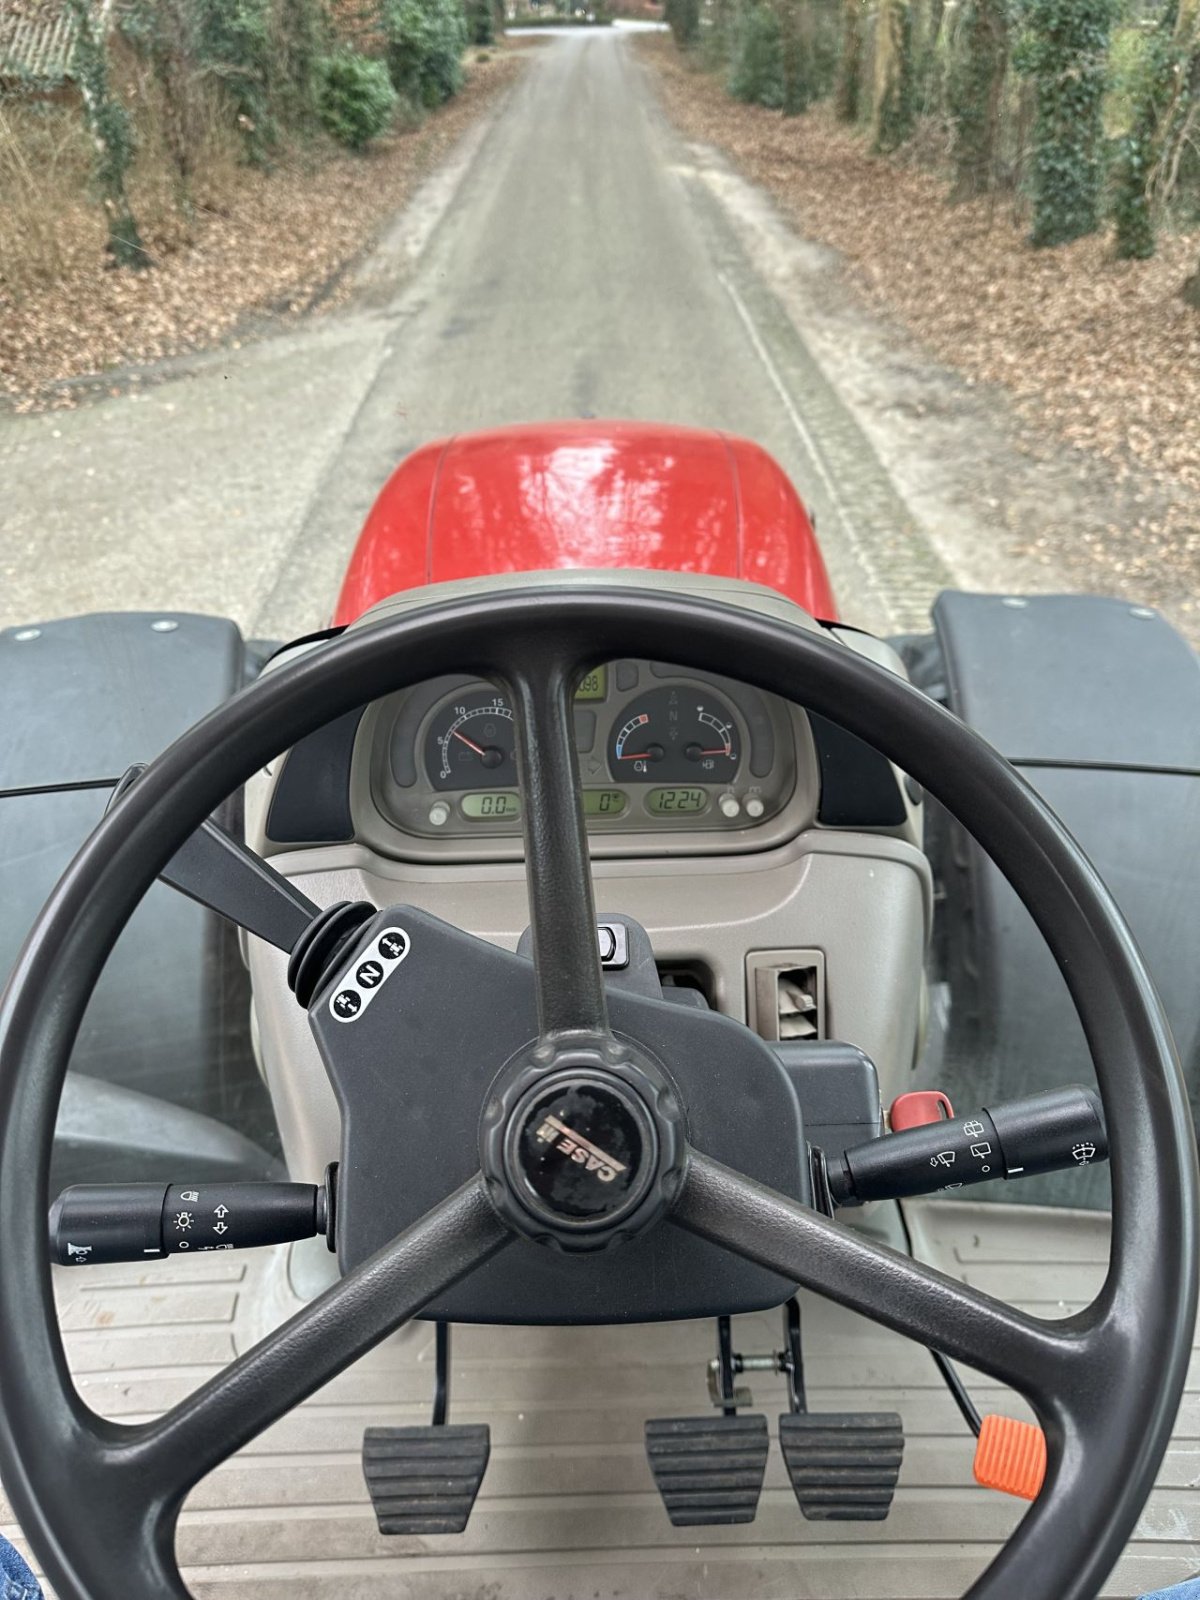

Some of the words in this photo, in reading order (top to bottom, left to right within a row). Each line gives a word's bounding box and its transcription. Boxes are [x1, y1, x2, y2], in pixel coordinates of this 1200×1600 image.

[491, 698, 504, 707] 15
[454, 706, 466, 715] 10
[437, 736, 444, 745] 5
[440, 771, 447, 779] 0
[480, 796, 506, 815] 0.0
[359, 964, 381, 985] N
[556, 1139, 617, 1182] CASE
